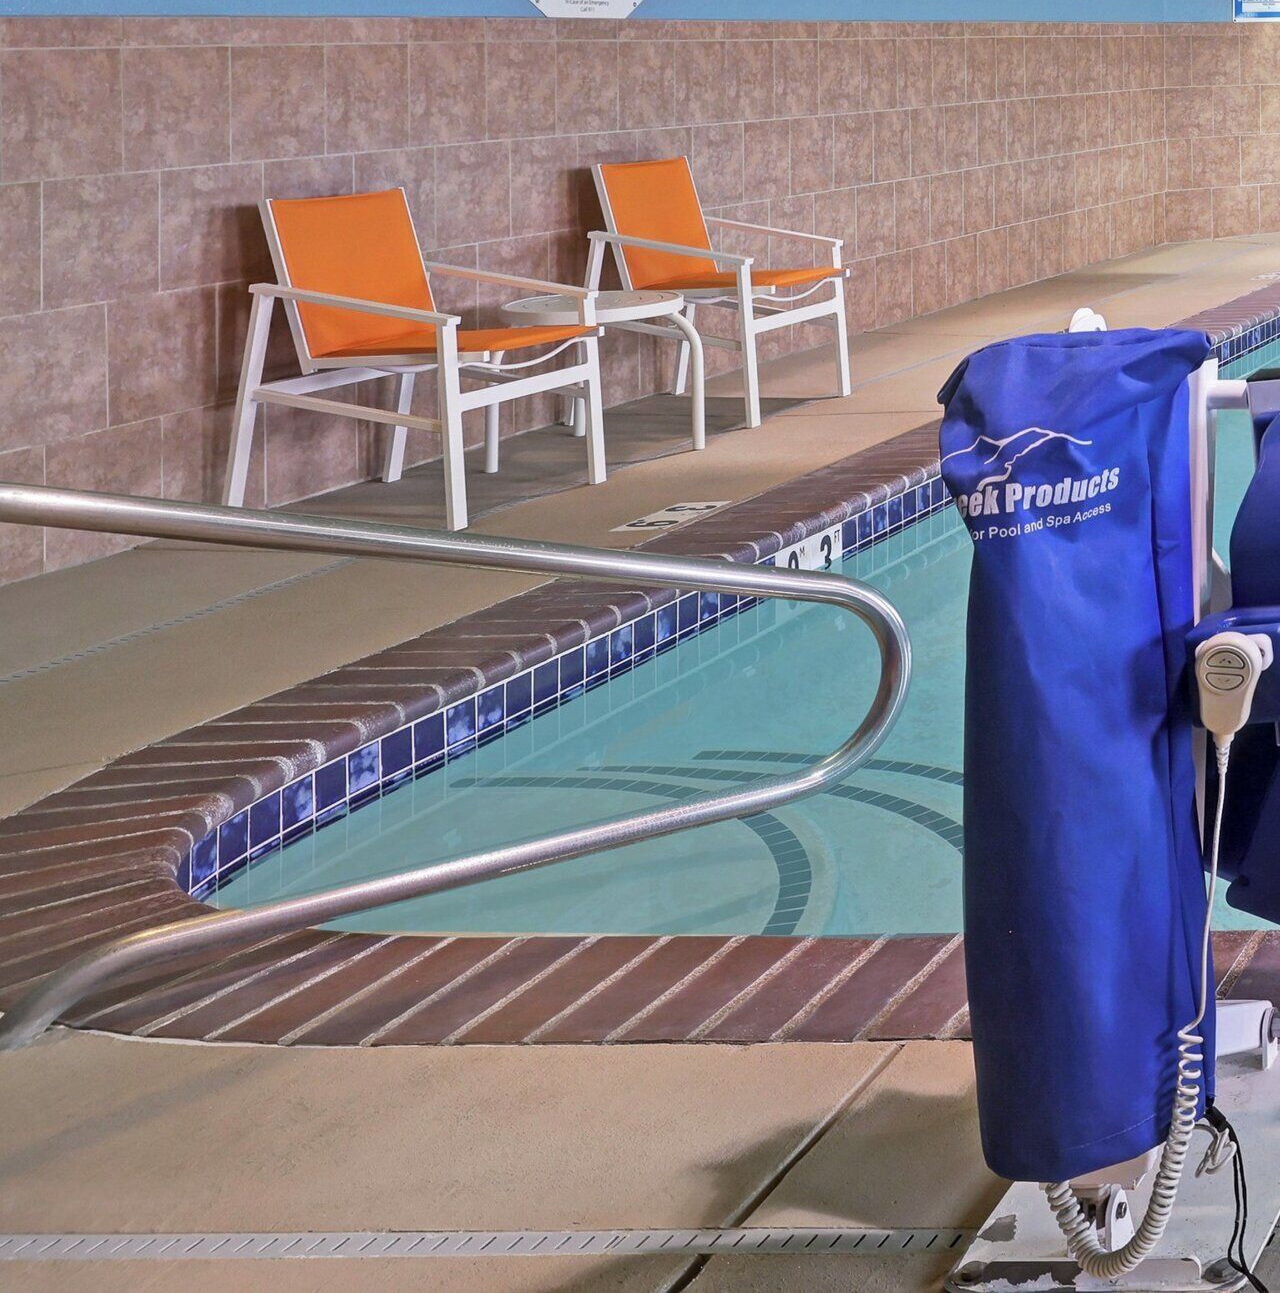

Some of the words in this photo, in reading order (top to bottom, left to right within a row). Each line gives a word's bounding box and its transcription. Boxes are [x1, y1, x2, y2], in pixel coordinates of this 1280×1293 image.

[954, 486, 999, 519] eek
[1006, 467, 1120, 513] Products
[834, 529, 841, 543] FT
[970, 528, 985, 541] or
[989, 523, 1021, 540] Pool
[1024, 518, 1043, 534] and
[1046, 515, 1071, 530] Spa
[1073, 502, 1111, 523] Access
